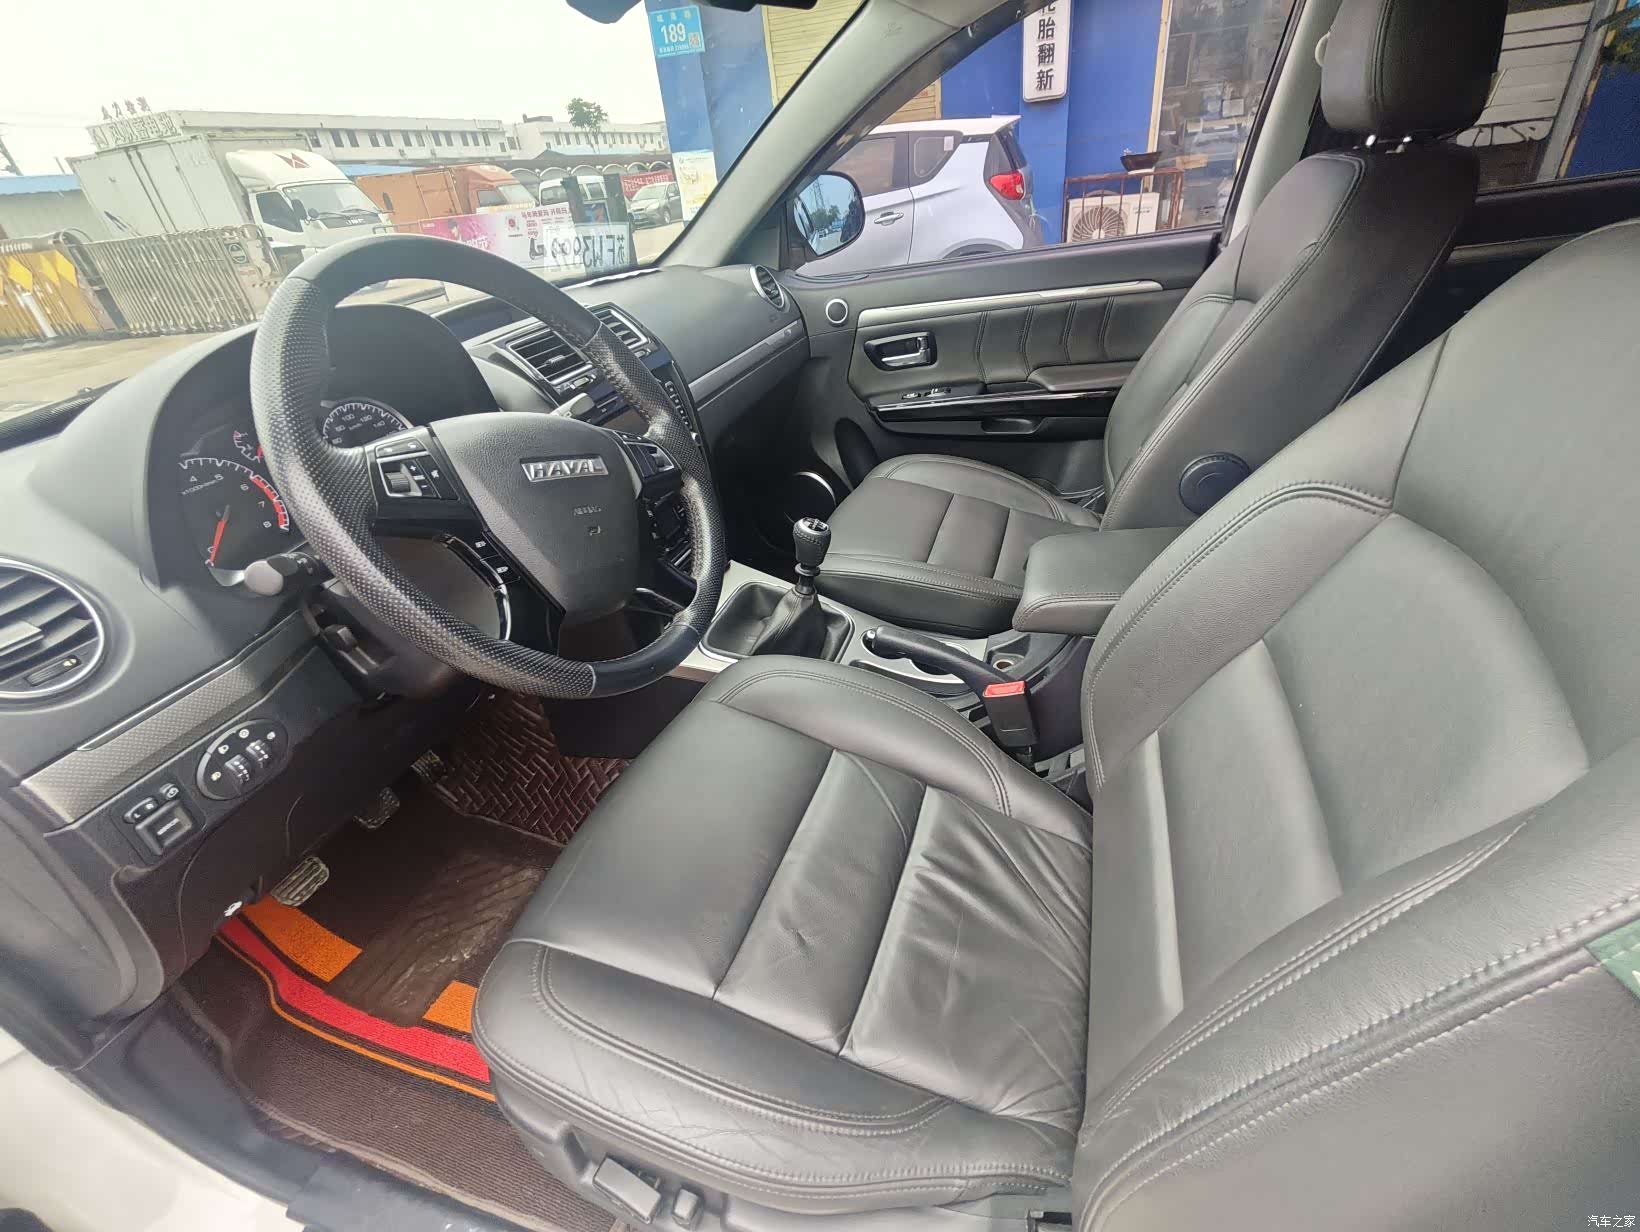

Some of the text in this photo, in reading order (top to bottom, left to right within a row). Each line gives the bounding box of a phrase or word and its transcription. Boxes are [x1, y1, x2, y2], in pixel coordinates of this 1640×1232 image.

[660, 22, 686, 44] 189
[214, 473, 224, 481] 5
[524, 458, 607, 481] HAVAL
[240, 483, 249, 491] 6
